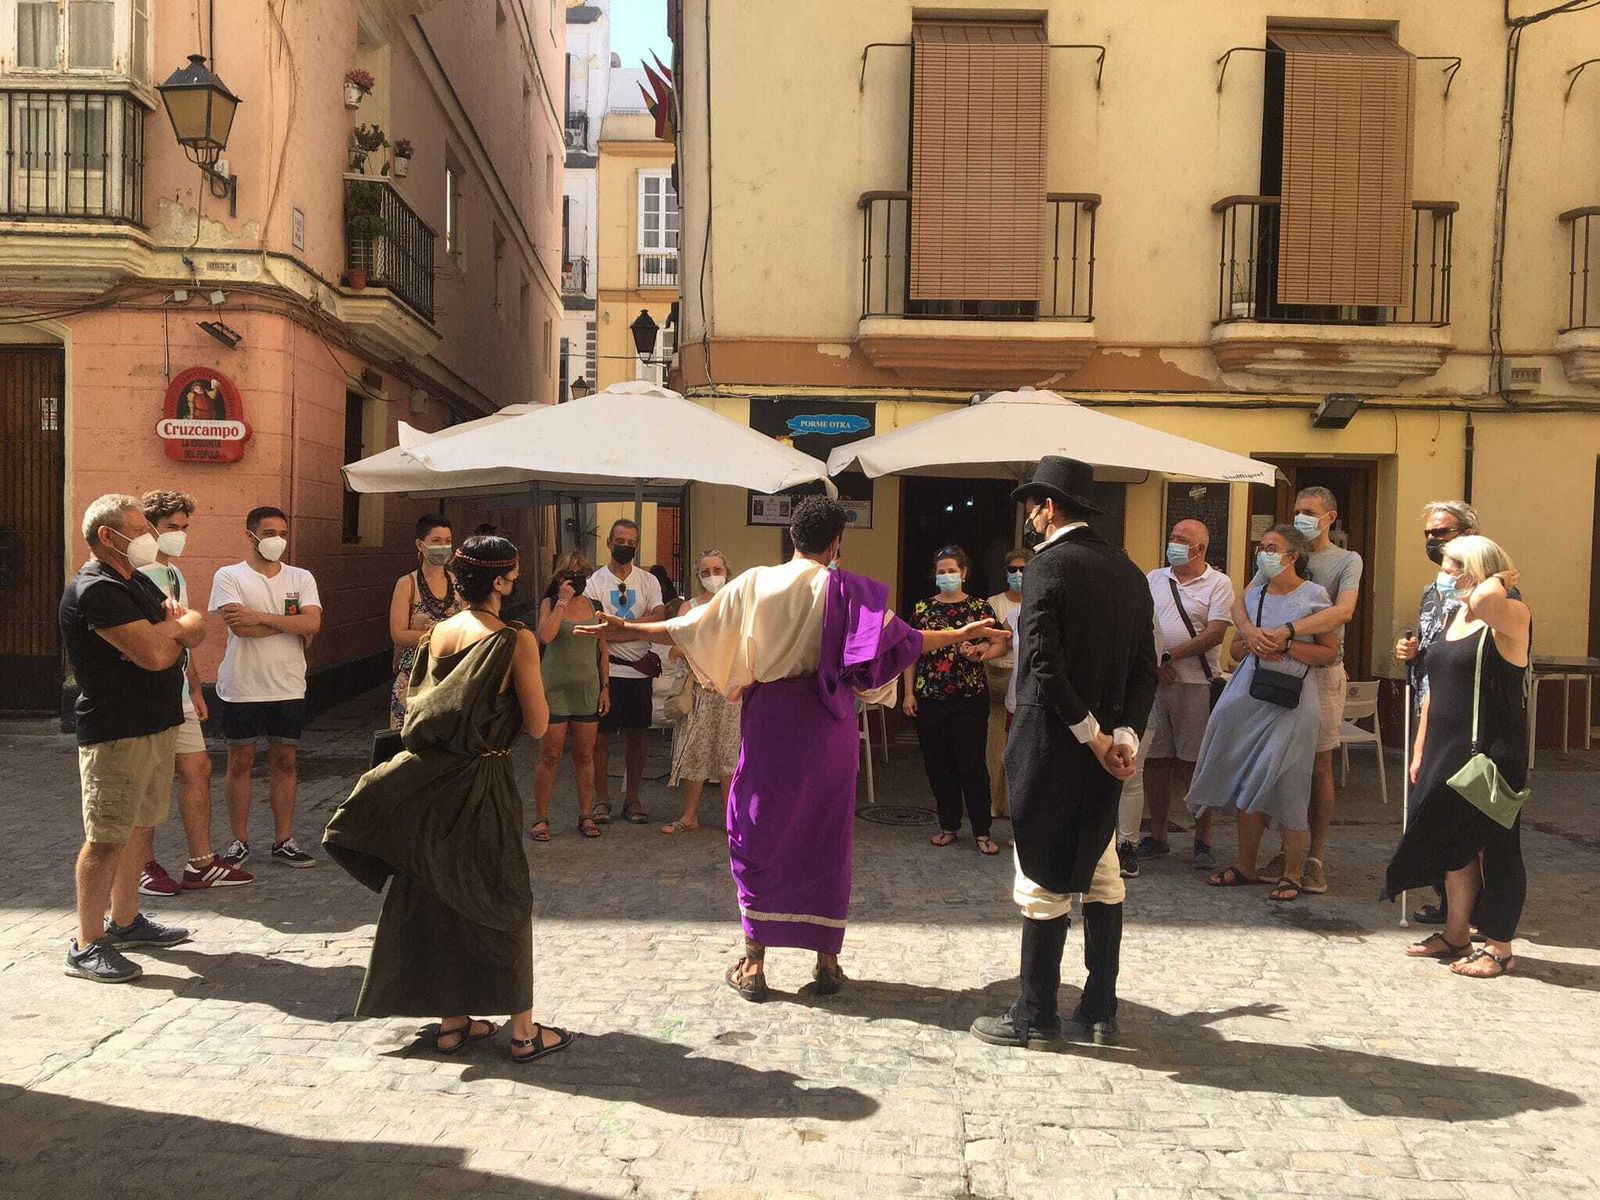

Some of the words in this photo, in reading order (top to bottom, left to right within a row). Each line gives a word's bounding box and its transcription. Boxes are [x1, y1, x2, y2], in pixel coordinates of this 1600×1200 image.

[164, 422, 239, 438] Cruzcampo
[800, 420, 828, 428] PORME
[829, 421, 851, 429] OTRA
